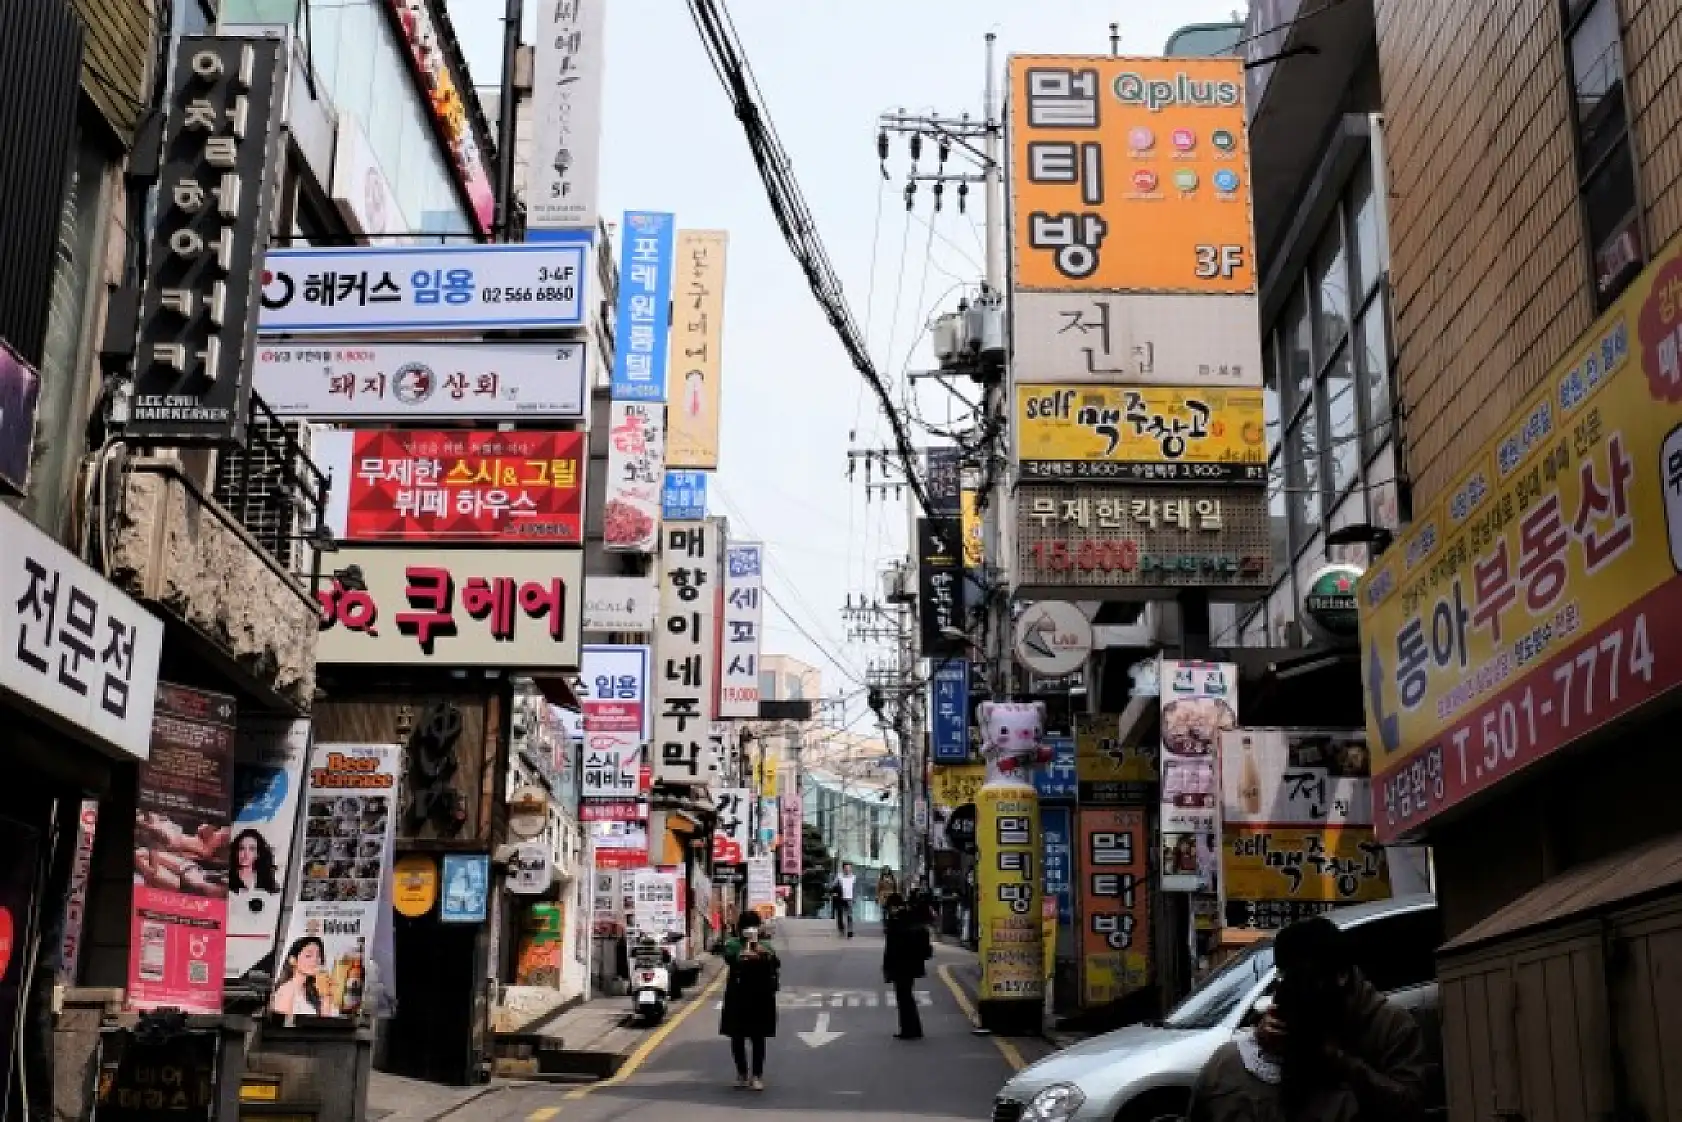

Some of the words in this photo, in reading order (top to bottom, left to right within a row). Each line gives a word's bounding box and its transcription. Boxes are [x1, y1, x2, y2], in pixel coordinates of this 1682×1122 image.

[1114, 74, 1239, 111] Qplus
[1027, 68, 1109, 278] 멀티방
[1195, 246, 1242, 278] 3F
[303, 270, 401, 306] 해커스
[410, 269, 475, 304] 임용
[482, 287, 501, 302] 02
[505, 287, 532, 301] 566
[536, 287, 574, 301] 6860
[136, 396, 163, 406] LEE
[328, 371, 386, 400] 돼지
[442, 371, 499, 399] 상회
[1027, 390, 1076, 420] self
[1077, 391, 1210, 457] 맥주창고
[356, 457, 442, 486] 무제한
[394, 489, 448, 519] 뷔페
[456, 489, 538, 519] 하우스
[16, 556, 137, 720] 전문점
[662, 527, 708, 776] 매향이네주막
[1452, 612, 1655, 785] T.501-7774
[586, 752, 620, 770] 스시
[996, 815, 1033, 915] 멀티방
[1090, 830, 1136, 950] 멀티방
